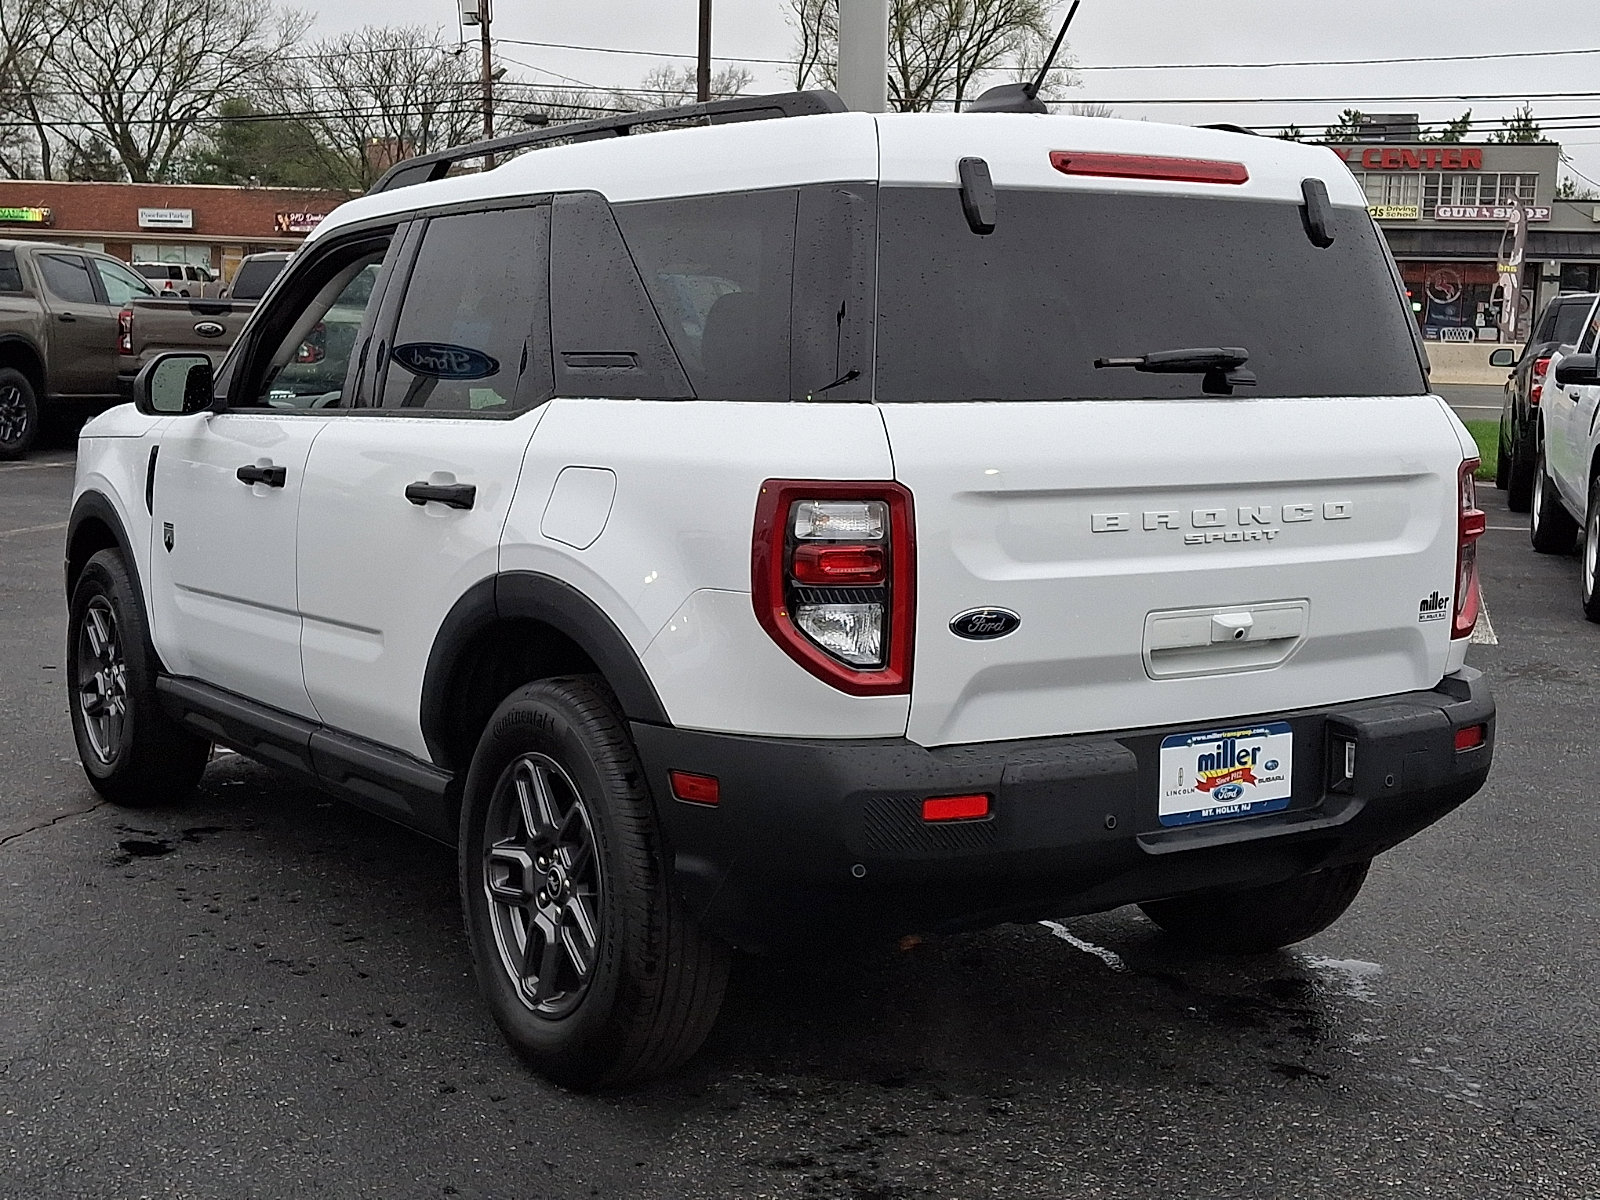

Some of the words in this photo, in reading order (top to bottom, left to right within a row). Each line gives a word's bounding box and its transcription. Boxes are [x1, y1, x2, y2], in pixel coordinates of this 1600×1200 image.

[1362, 148, 1483, 169] CENTER
[1386, 206, 1417, 214] Driving
[1438, 207, 1479, 218] GUN
[1091, 501, 1352, 532] BRONCO
[1184, 529, 1280, 545] SPORT
[1420, 591, 1449, 612] miller
[967, 614, 1006, 633] Ford
[494, 709, 548, 739] Continental
[1198, 739, 1261, 772] miller
[1215, 776, 1231, 786] Since
[1258, 775, 1285, 784] SUBARU
[1166, 788, 1195, 797] LINCOLN
[1218, 786, 1238, 800] Ford
[1201, 809, 1215, 817] MT.
[1215, 805, 1240, 816] HOLLY,
[1241, 803, 1252, 812] NJ
